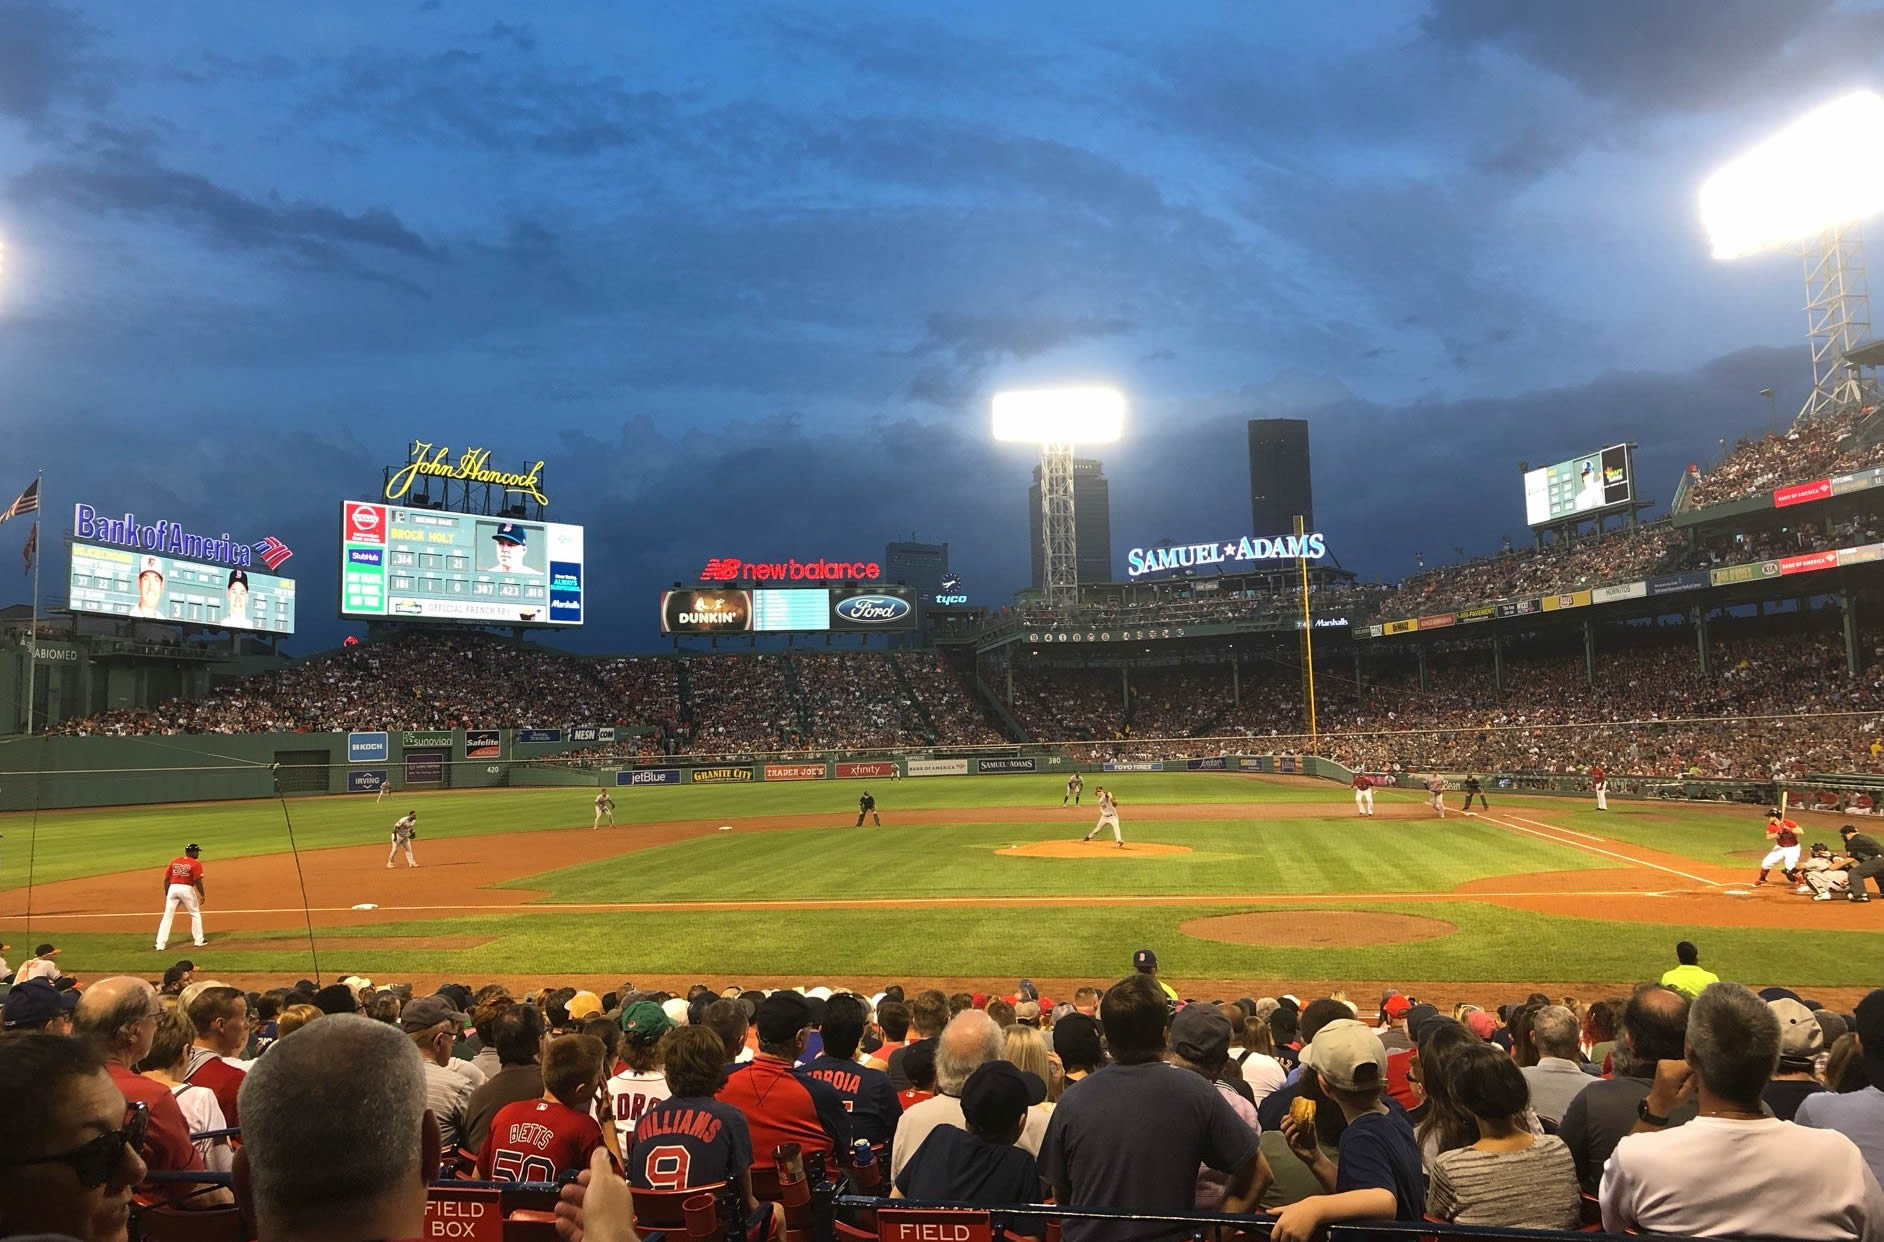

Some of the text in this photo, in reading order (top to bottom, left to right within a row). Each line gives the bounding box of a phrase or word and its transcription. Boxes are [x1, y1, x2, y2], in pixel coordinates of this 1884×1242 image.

[386, 440, 549, 506] John Hancock
[74, 503, 141, 548] Bank
[142, 520, 168, 551] of
[169, 523, 251, 567] America
[1128, 533, 1326, 576] SAMUEL ADAMS
[1763, 564, 1776, 574] KIA
[936, 594, 968, 606] tyco
[851, 599, 894, 618] Ford
[679, 613, 736, 624] DUNKIN'
[1315, 617, 1349, 627] Marshalls
[34, 649, 77, 661] ABIOMED
[413, 737, 452, 746] sunovion
[574, 731, 595, 740] NESN
[360, 743, 383, 751] KOCH
[693, 769, 752, 781] GRANITE CITY
[801, 767, 824, 776] JOE'S
[850, 766, 881, 776] xfinity
[631, 772, 666, 784] jetBlue
[172, 863, 192, 877] 52
[637, 1109, 722, 1144] WILLIAMS
[509, 1122, 554, 1150] BETTS
[492, 1149, 556, 1182] 50
[645, 1145, 691, 1191] 9
[424, 1201, 485, 1218] FIELD
[432, 1221, 475, 1238] BOX
[900, 1224, 970, 1241] FIELD
